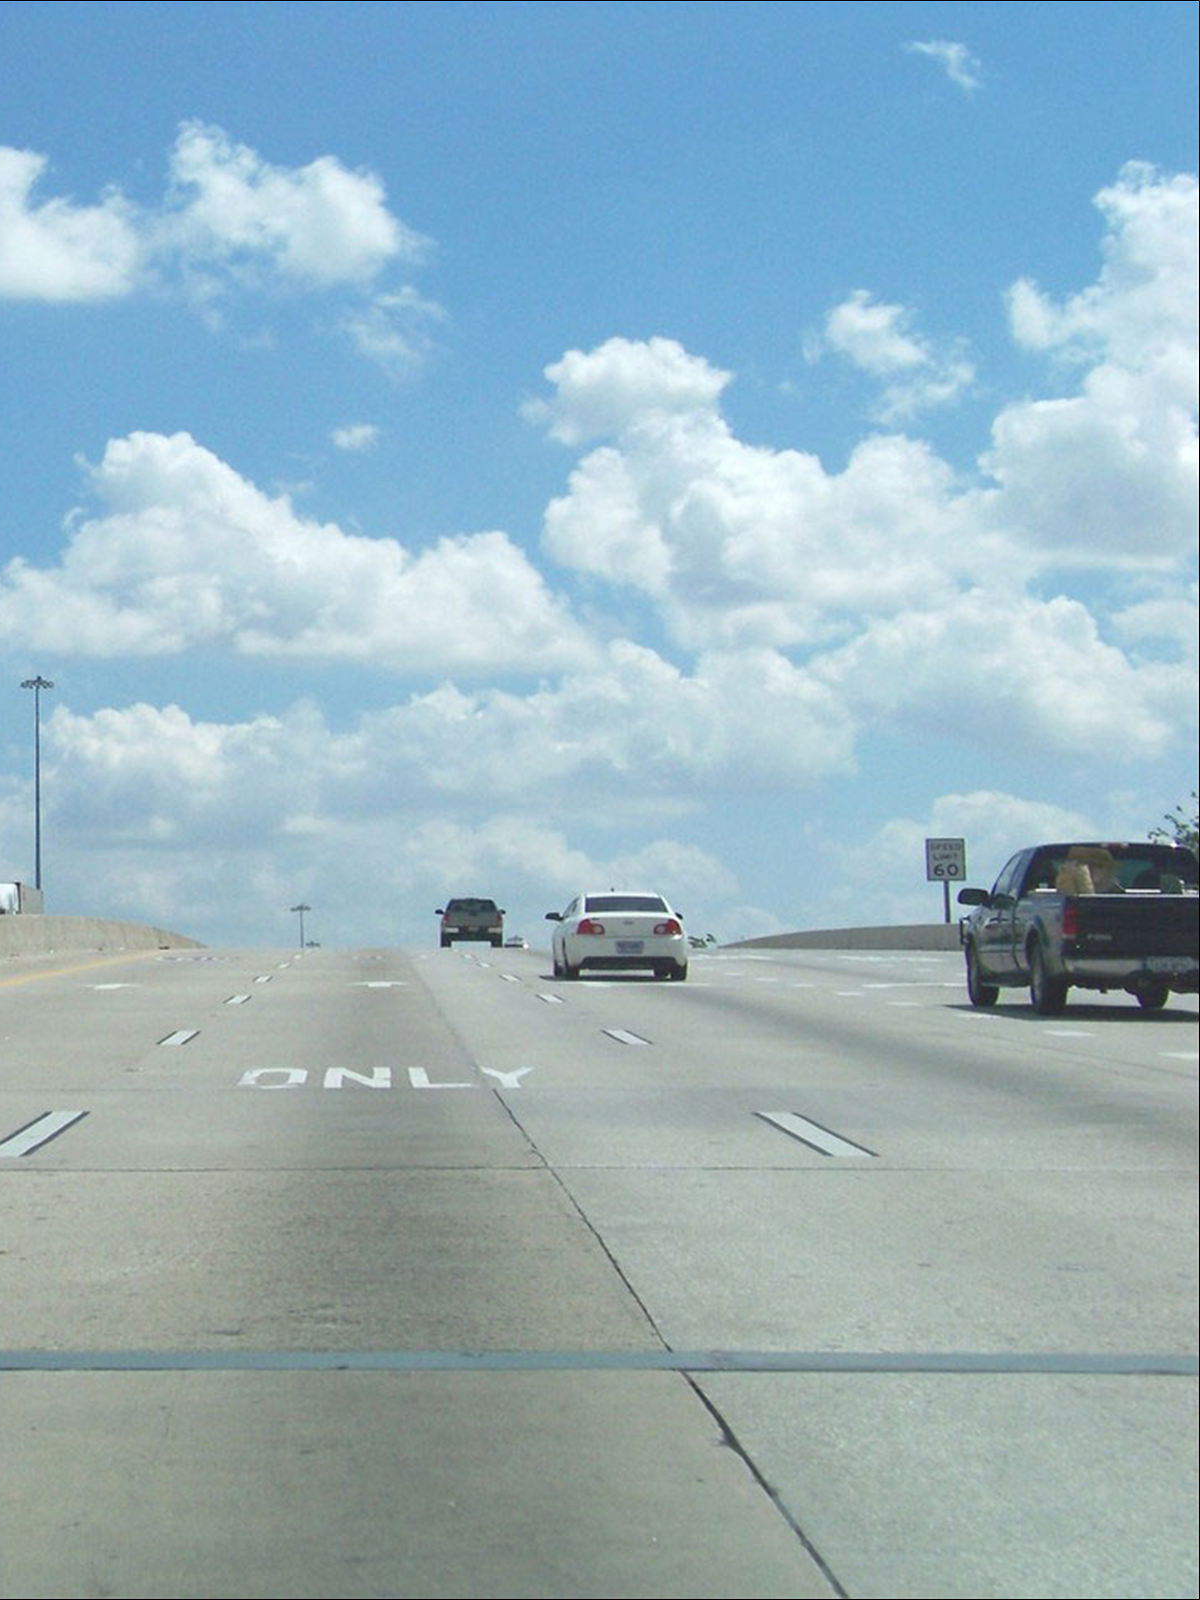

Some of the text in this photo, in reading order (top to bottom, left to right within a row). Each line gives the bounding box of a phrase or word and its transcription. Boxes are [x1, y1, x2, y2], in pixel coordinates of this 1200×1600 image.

[930, 843, 960, 851] SPEED
[933, 863, 959, 876] 60
[237, 1065, 535, 1090] ONLY
